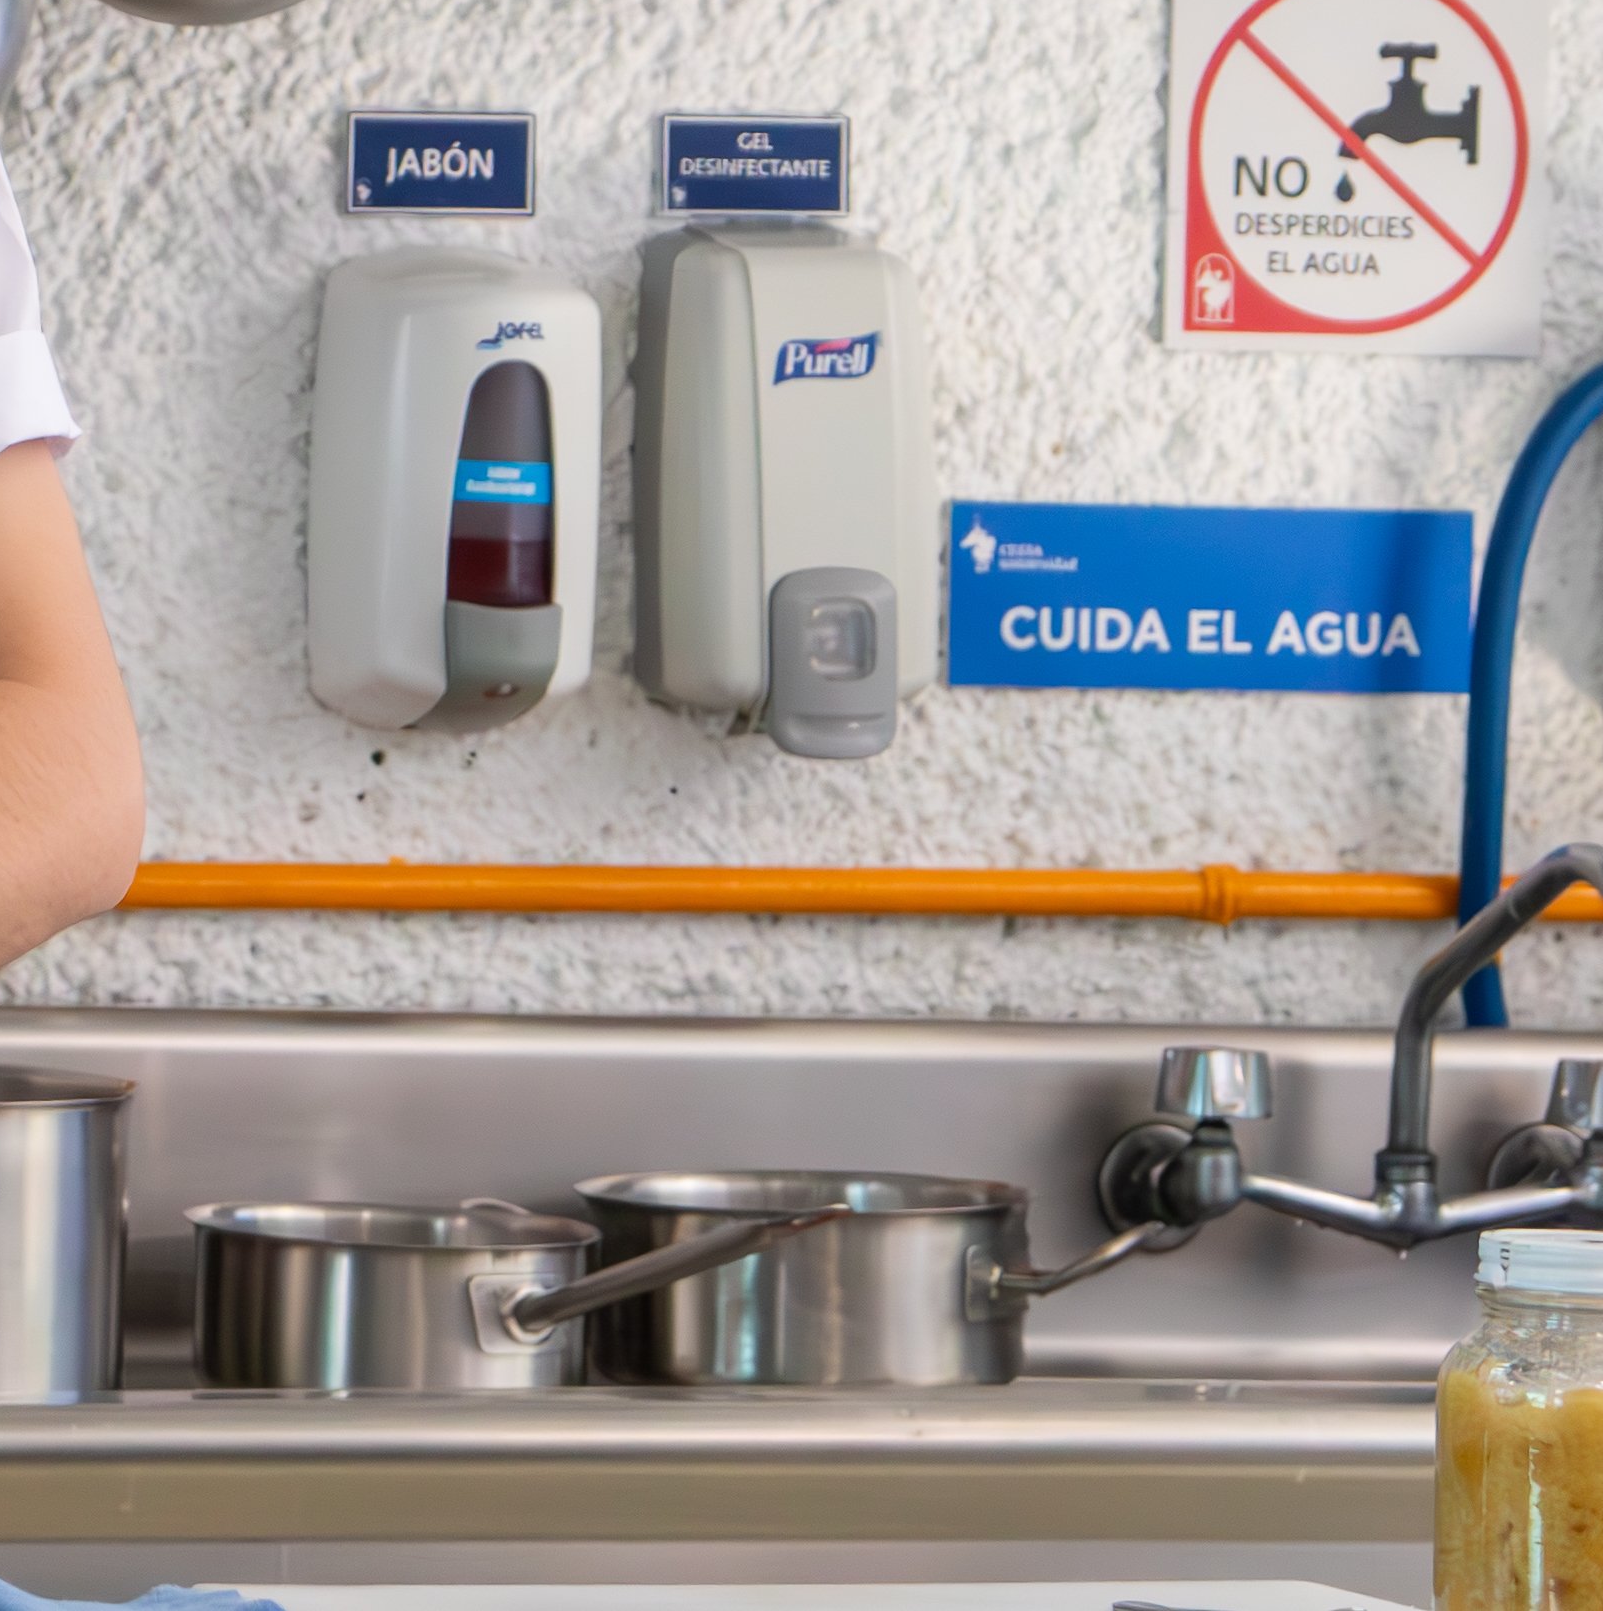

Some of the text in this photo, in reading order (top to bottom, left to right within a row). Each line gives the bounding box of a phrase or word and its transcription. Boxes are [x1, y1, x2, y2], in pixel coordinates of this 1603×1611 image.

[736, 132, 774, 151] GEL
[386, 141, 495, 184] JABÓN
[679, 157, 832, 178] DESINFECTANTE
[1232, 155, 1310, 199] NO
[1235, 212, 1415, 239] DESPERDICIES
[1266, 250, 1380, 276] EL AGUA
[999, 605, 1422, 658] CUIDA EL AGUA
